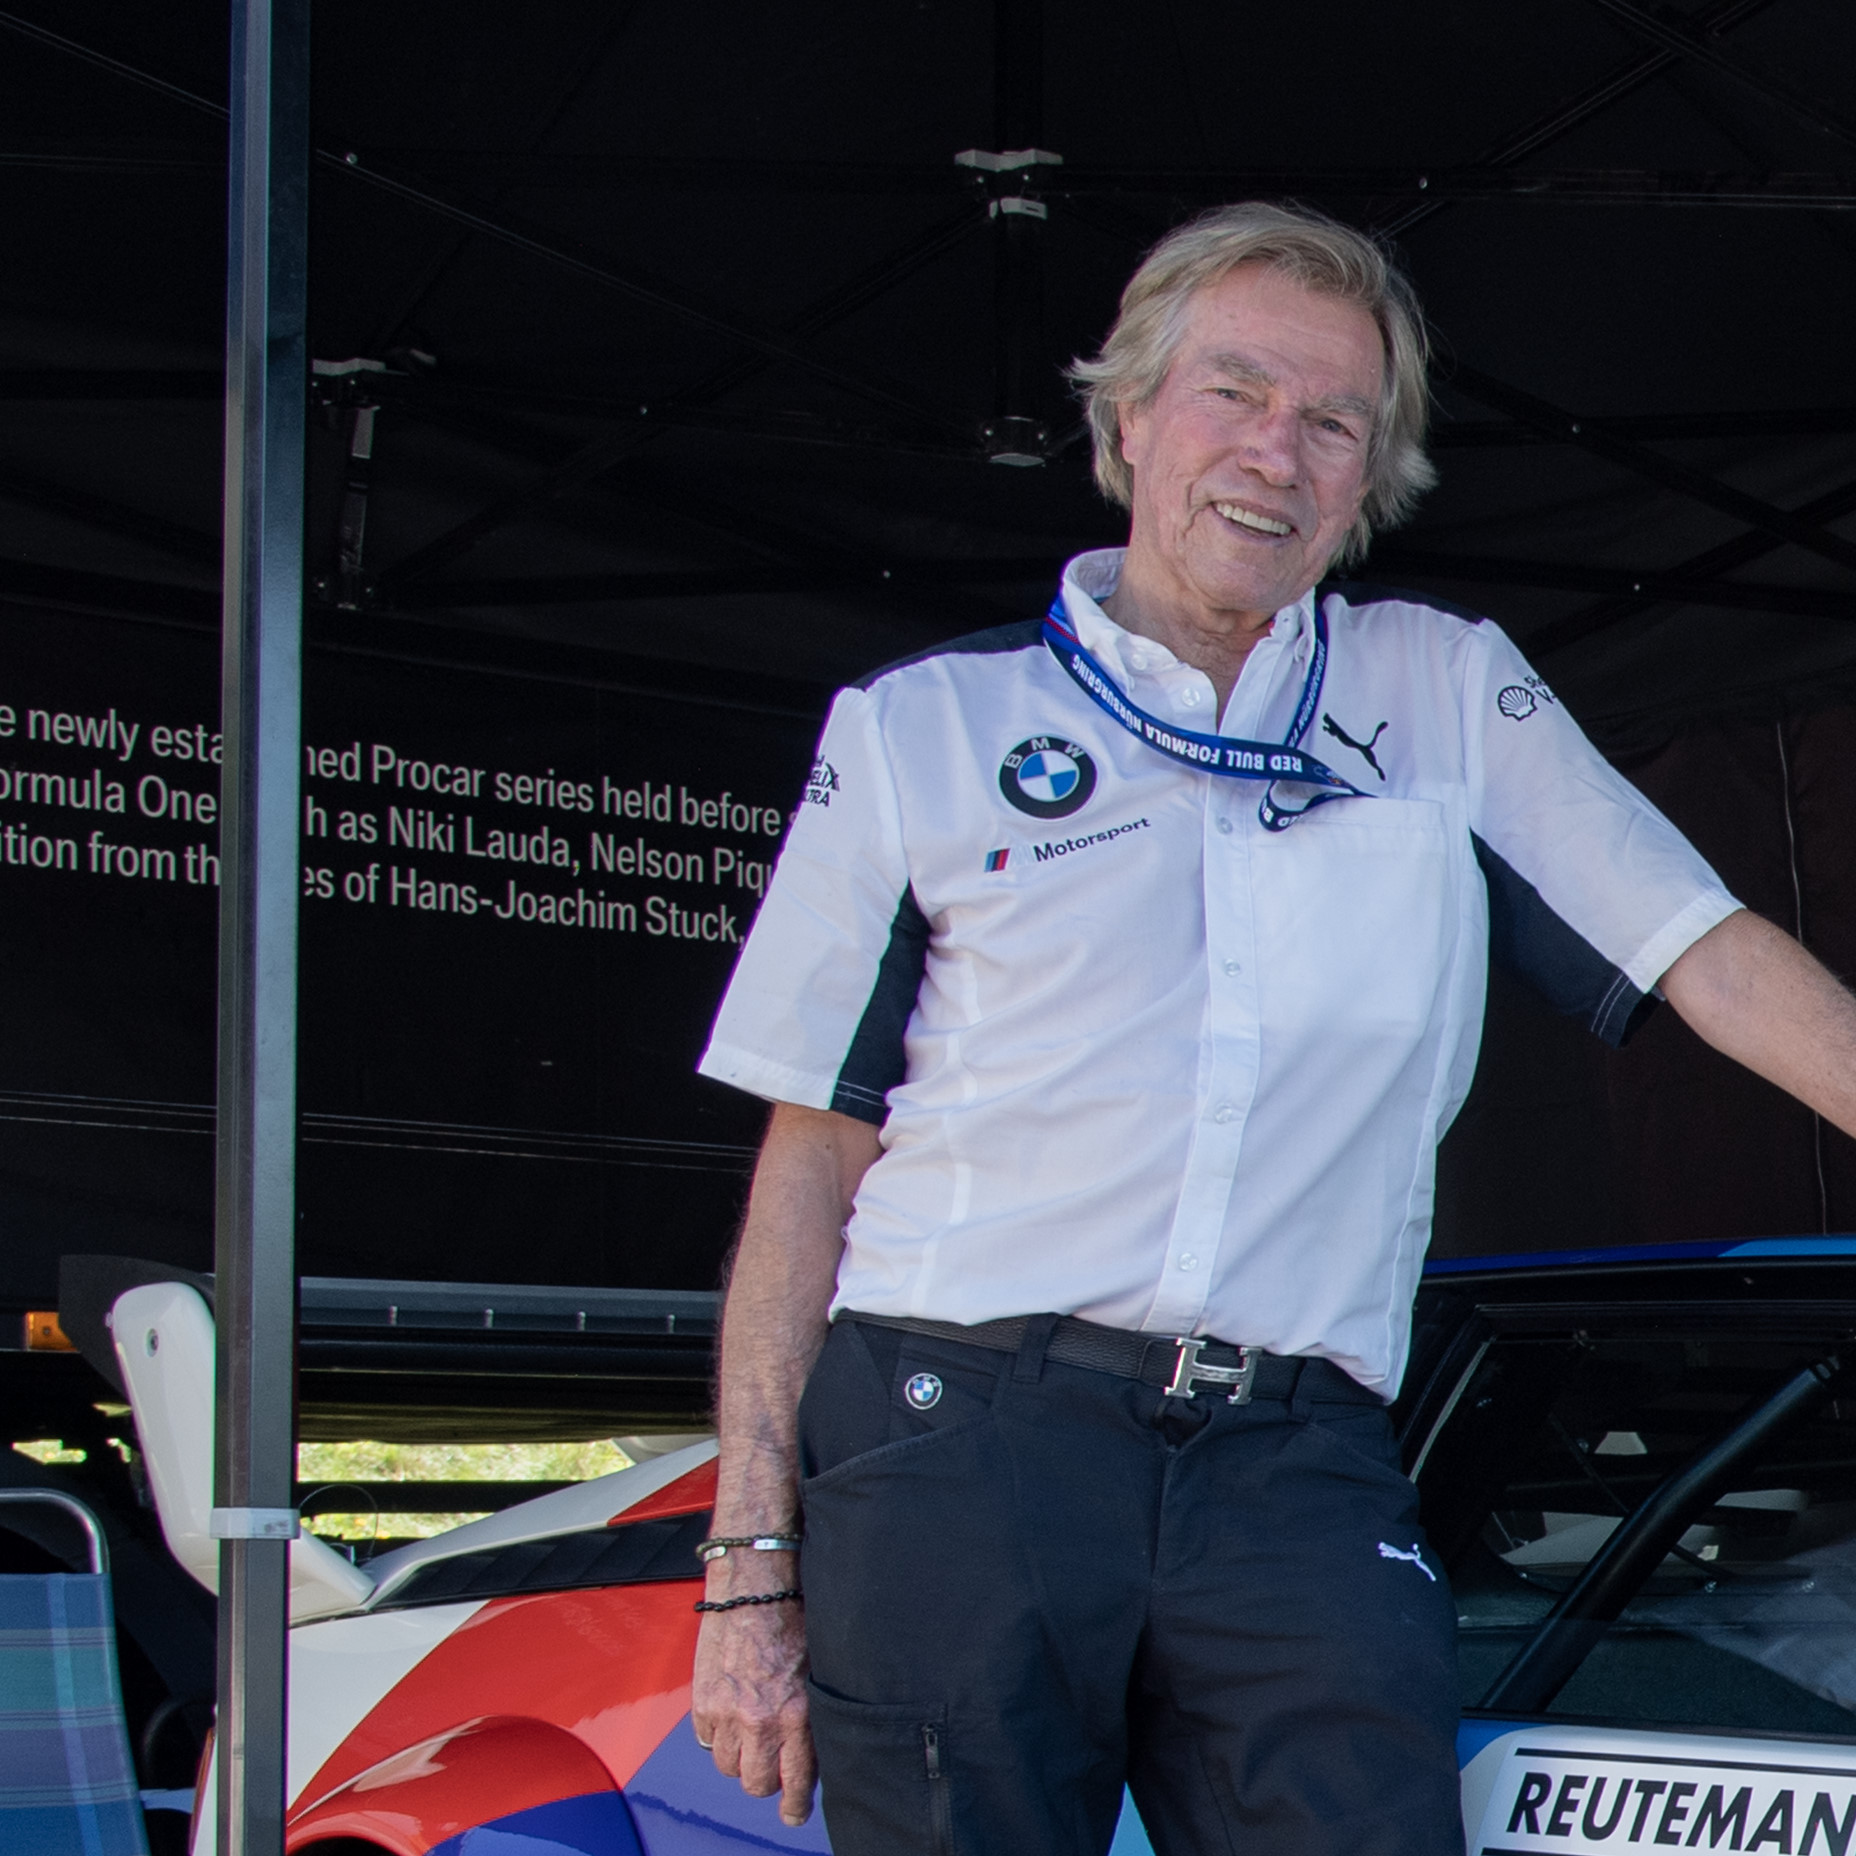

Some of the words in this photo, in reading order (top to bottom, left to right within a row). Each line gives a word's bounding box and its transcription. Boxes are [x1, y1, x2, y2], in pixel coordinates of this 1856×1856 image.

[1003, 737, 1086, 769] BMW
[1145, 723, 1220, 764] FORMULA
[1228, 750, 1265, 771] BULL
[1270, 754, 1303, 773] RED
[27, 708, 140, 761] newly
[371, 743, 486, 797] Procar
[494, 768, 594, 813] series
[603, 775, 671, 823] held
[680, 786, 781, 836] before
[0, 769, 126, 814] ormula
[137, 774, 217, 825] One
[337, 810, 378, 844] as
[389, 805, 455, 853] Niki
[465, 815, 581, 877] Lauda,
[591, 831, 704, 883] Nelson
[1033, 818, 1151, 862] Motorsport
[88, 831, 176, 882] from
[184, 843, 221, 886] th
[344, 862, 380, 903] of
[390, 865, 637, 932] Hans-Joachim
